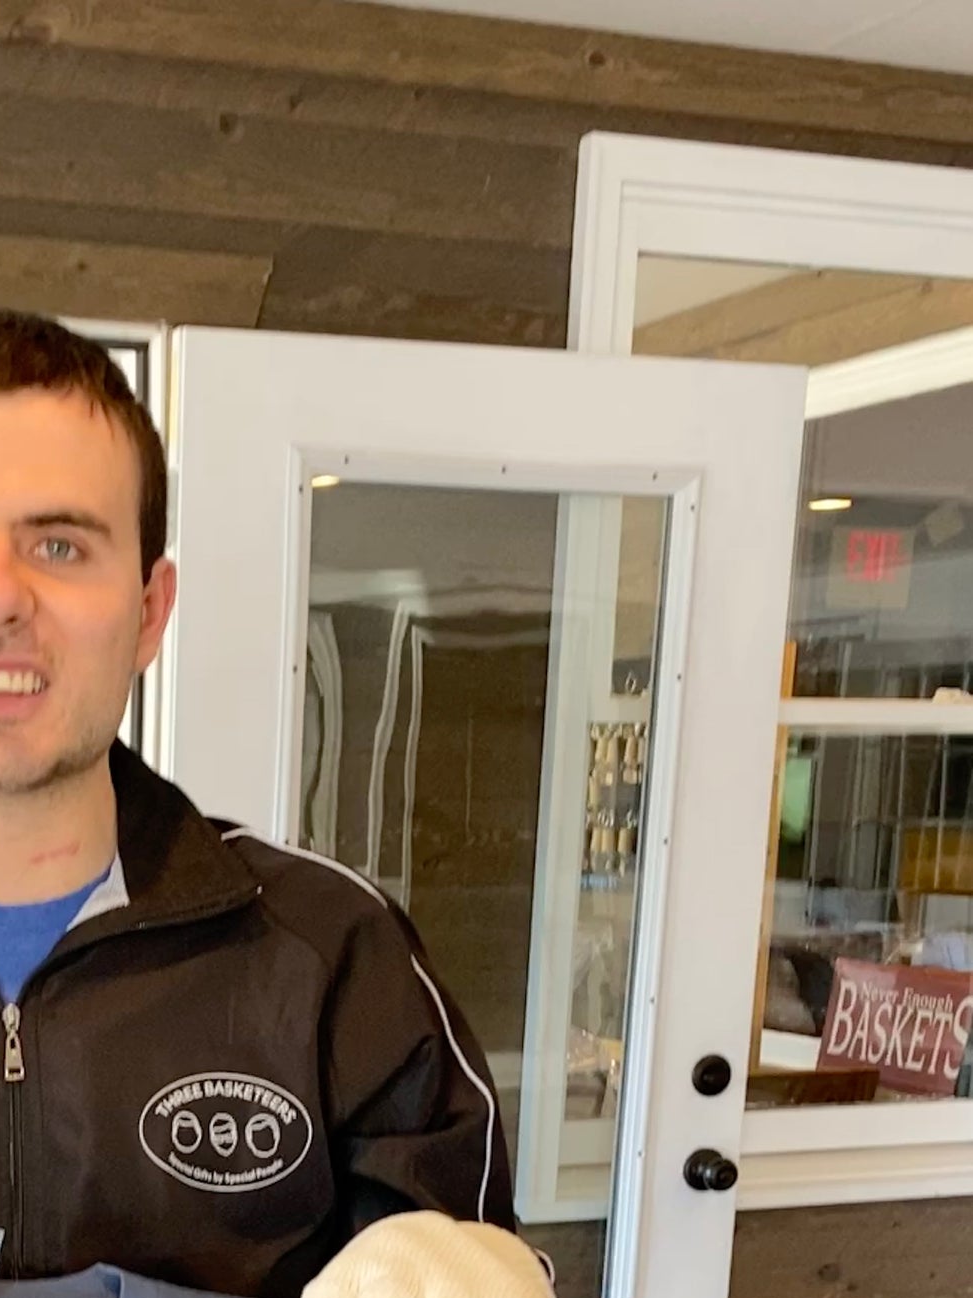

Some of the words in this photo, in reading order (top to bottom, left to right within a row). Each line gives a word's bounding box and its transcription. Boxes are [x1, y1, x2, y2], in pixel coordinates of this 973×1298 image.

[860, 981, 898, 1003] Never
[901, 986, 953, 1013] Enough
[827, 978, 973, 1080] BASKETS
[155, 1082, 203, 1118] THREE
[203, 1080, 298, 1126] BASKETEERS
